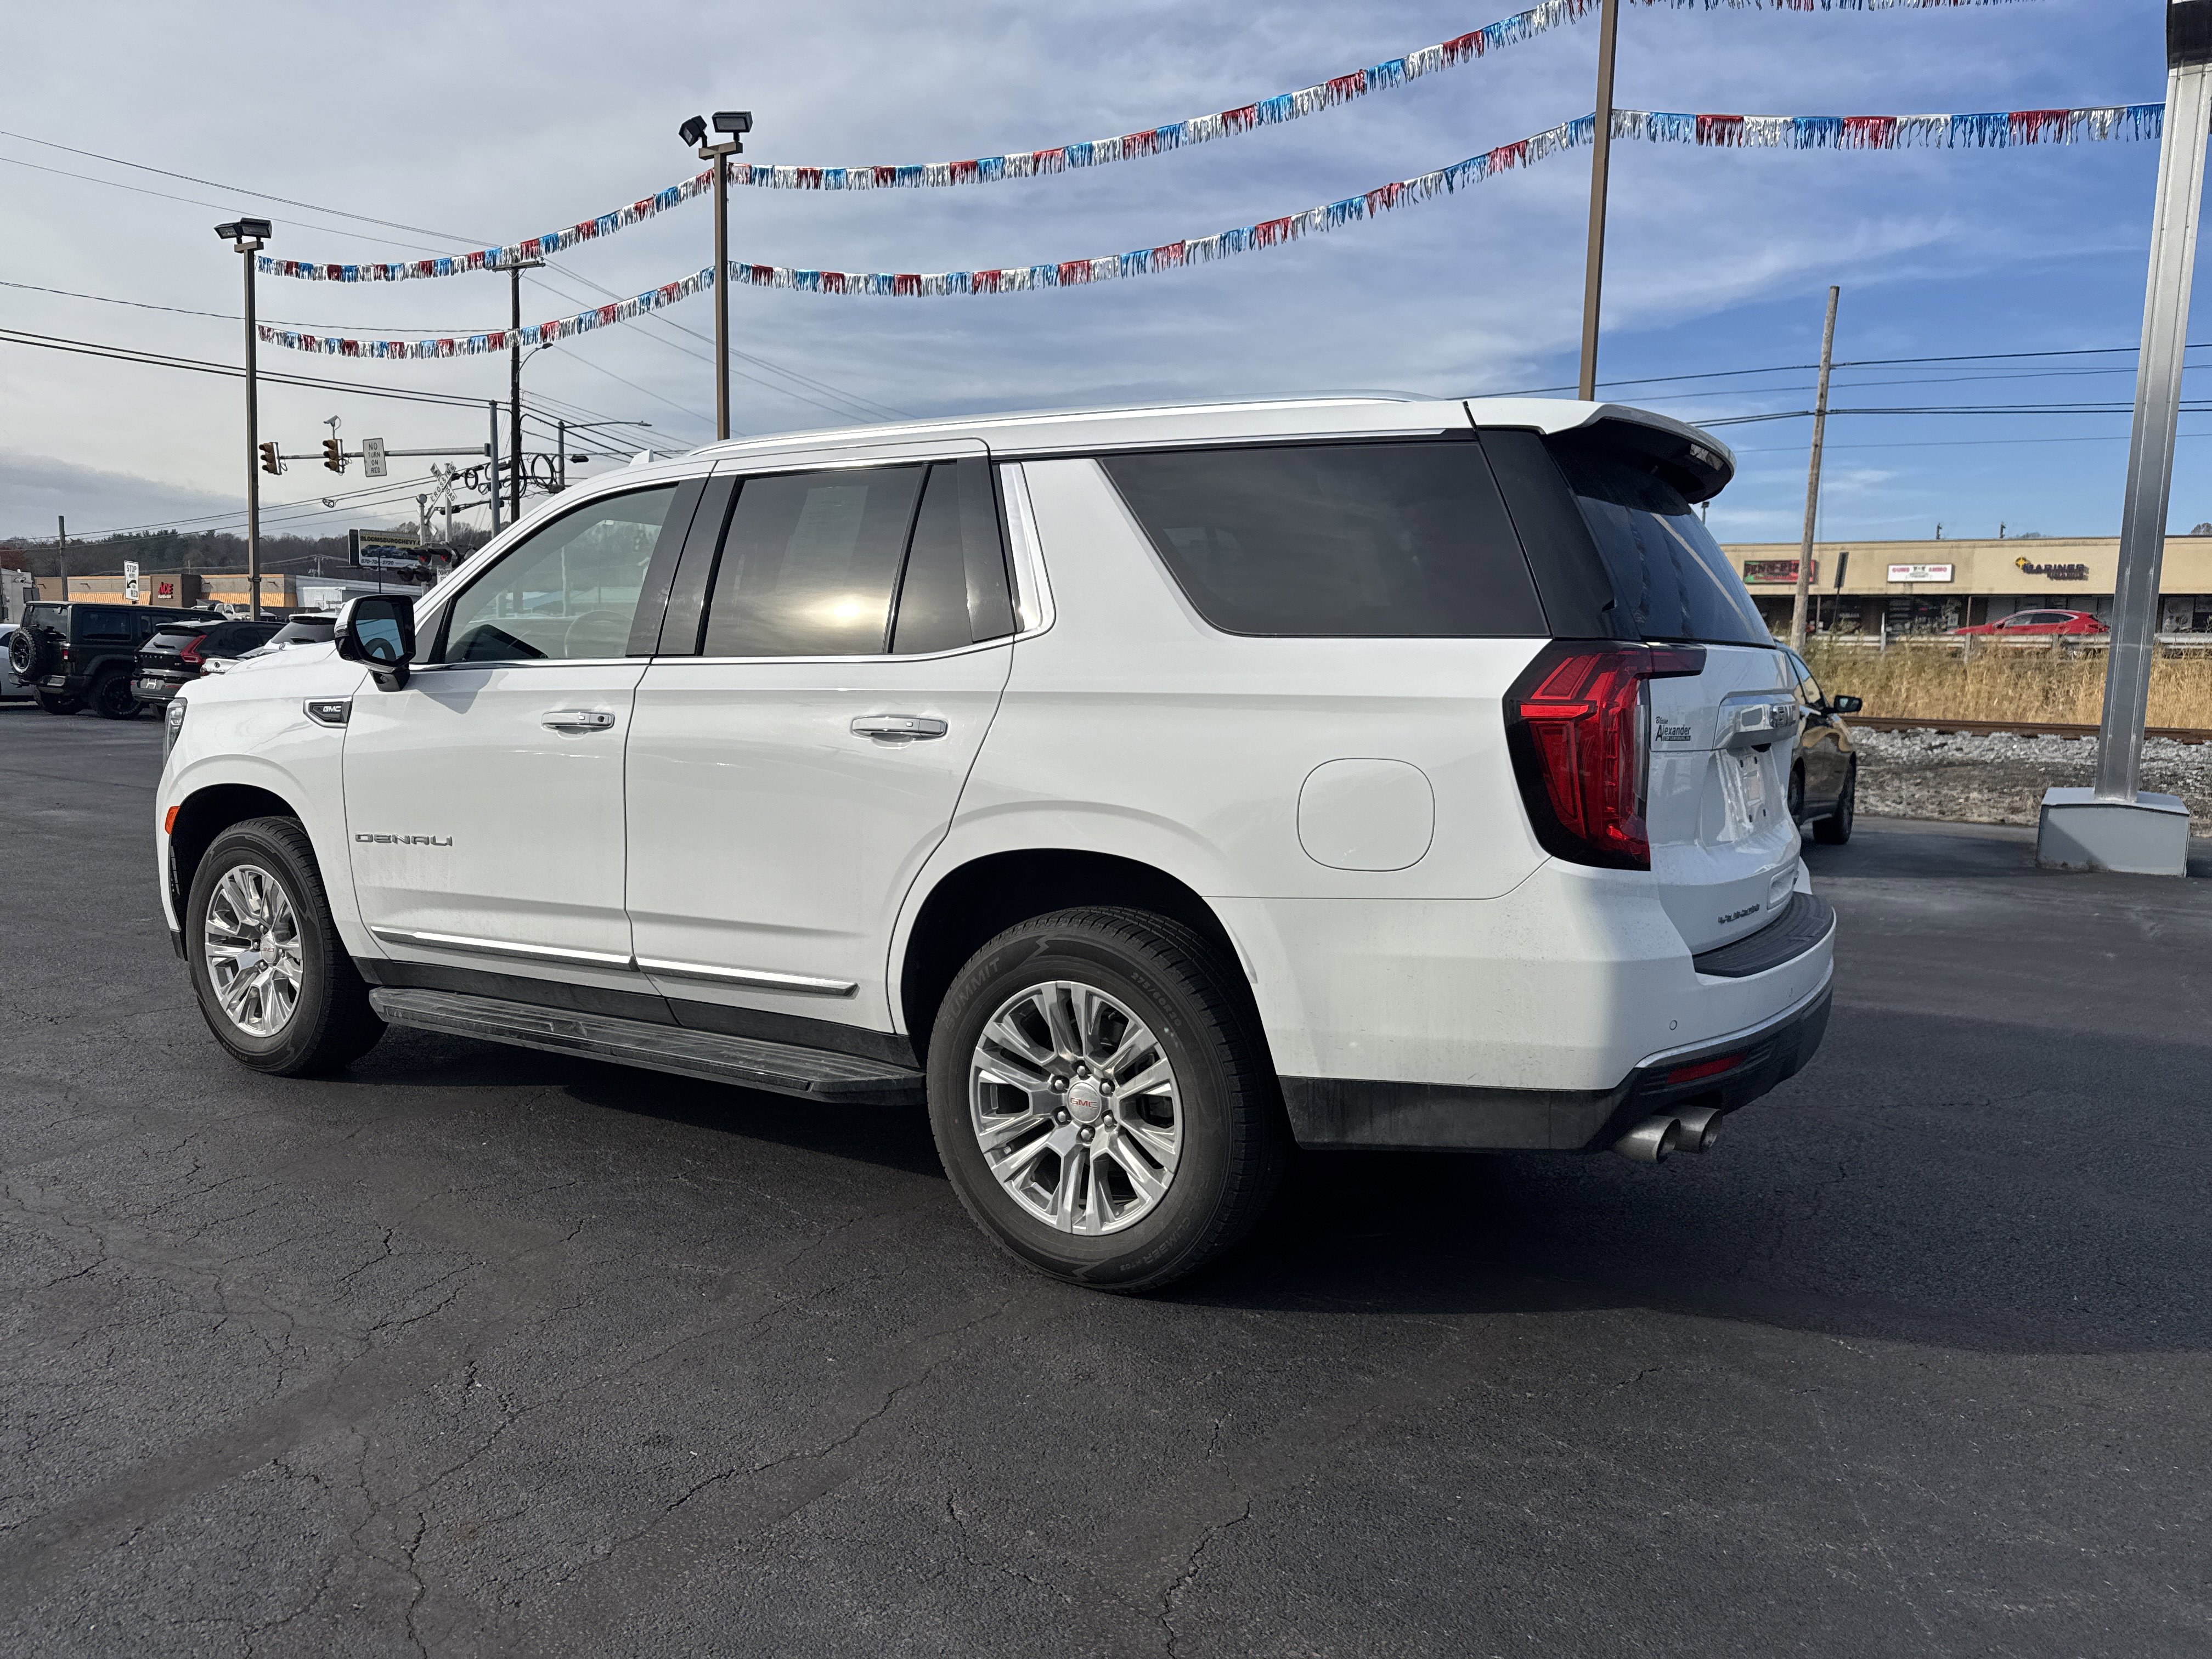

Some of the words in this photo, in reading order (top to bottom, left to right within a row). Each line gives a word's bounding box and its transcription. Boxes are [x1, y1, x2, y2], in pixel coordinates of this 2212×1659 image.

[368, 442, 377, 450] NO
[431, 464, 442, 482] RAIL
[445, 485, 455, 501] ROAD
[431, 464, 455, 502] CROSSING
[126, 565, 137, 573] STOP
[2022, 564, 2086, 574] MARINER
[1655, 724, 1691, 741] Alexander
[354, 833, 453, 847] DENALI
[942, 957, 1000, 1032] SUMMIT
[1131, 972, 1182, 1026] 275/60R20
[1070, 1097, 1098, 1109] GMC
